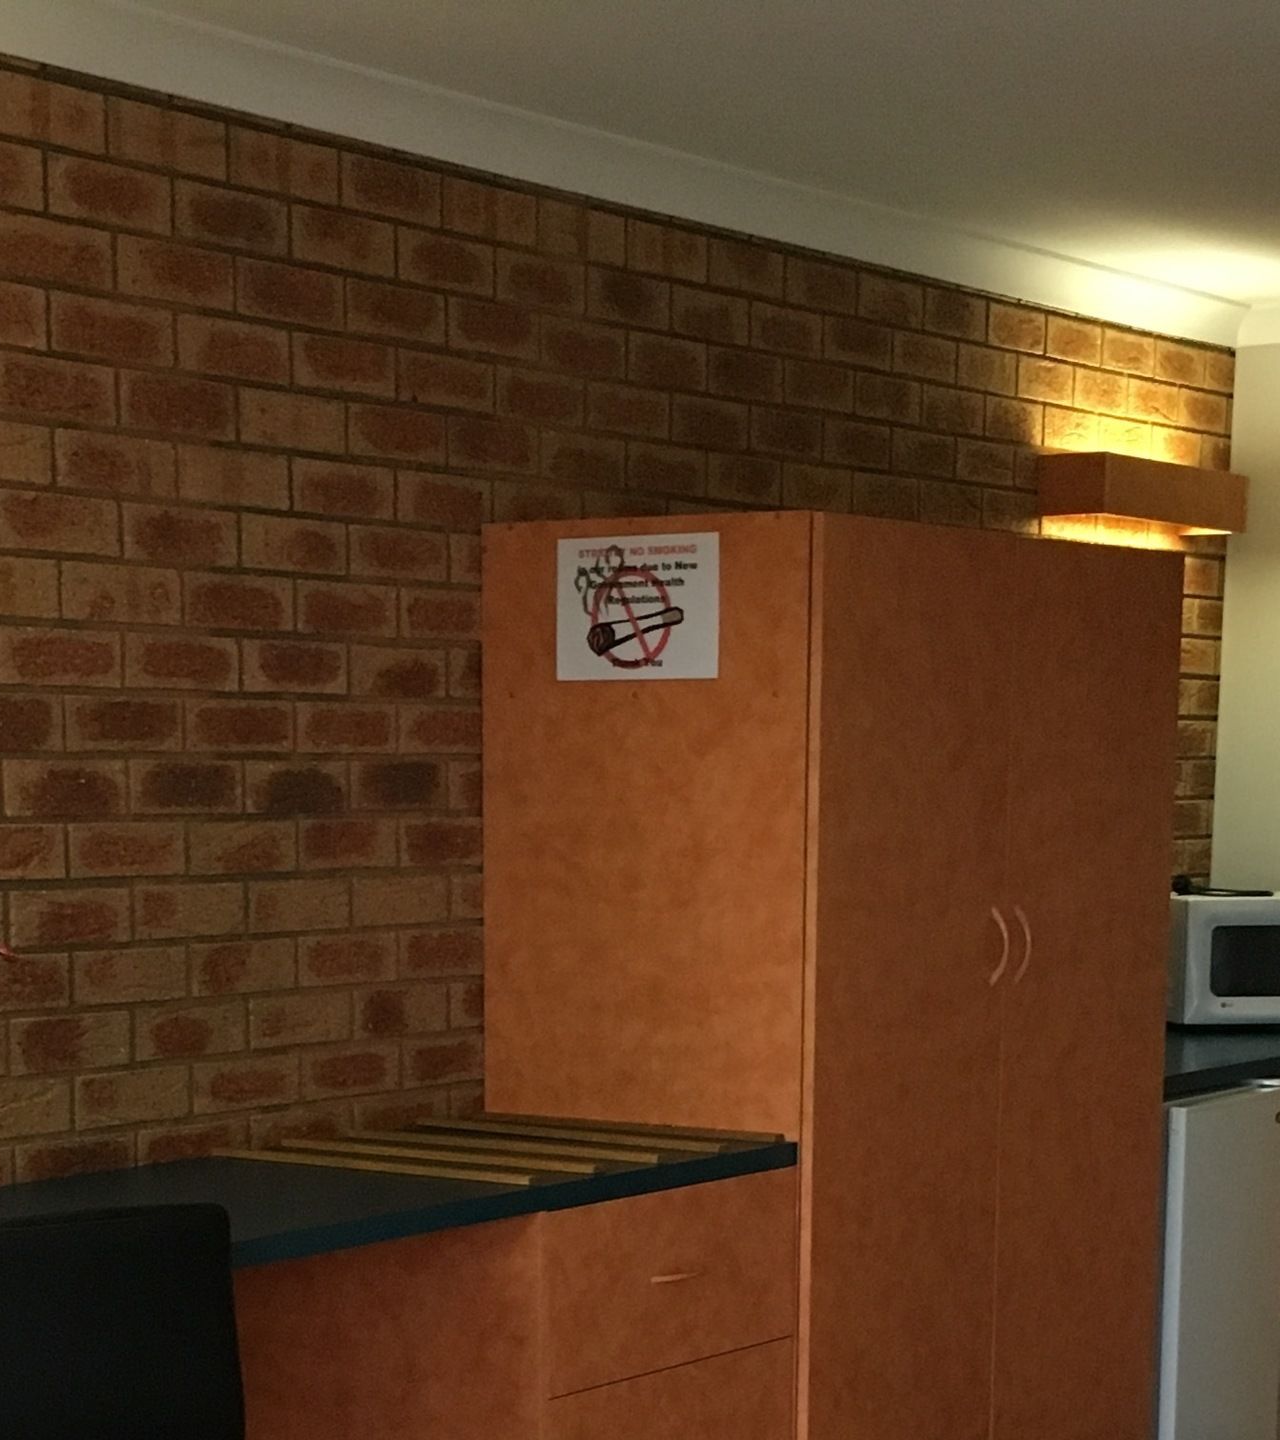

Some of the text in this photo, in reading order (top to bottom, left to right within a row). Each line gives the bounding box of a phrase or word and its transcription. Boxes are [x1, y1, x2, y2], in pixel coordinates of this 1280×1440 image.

[630, 546, 645, 556] NO
[647, 544, 697, 555] SMOKING
[662, 562, 672, 571] to
[675, 561, 698, 570] New
